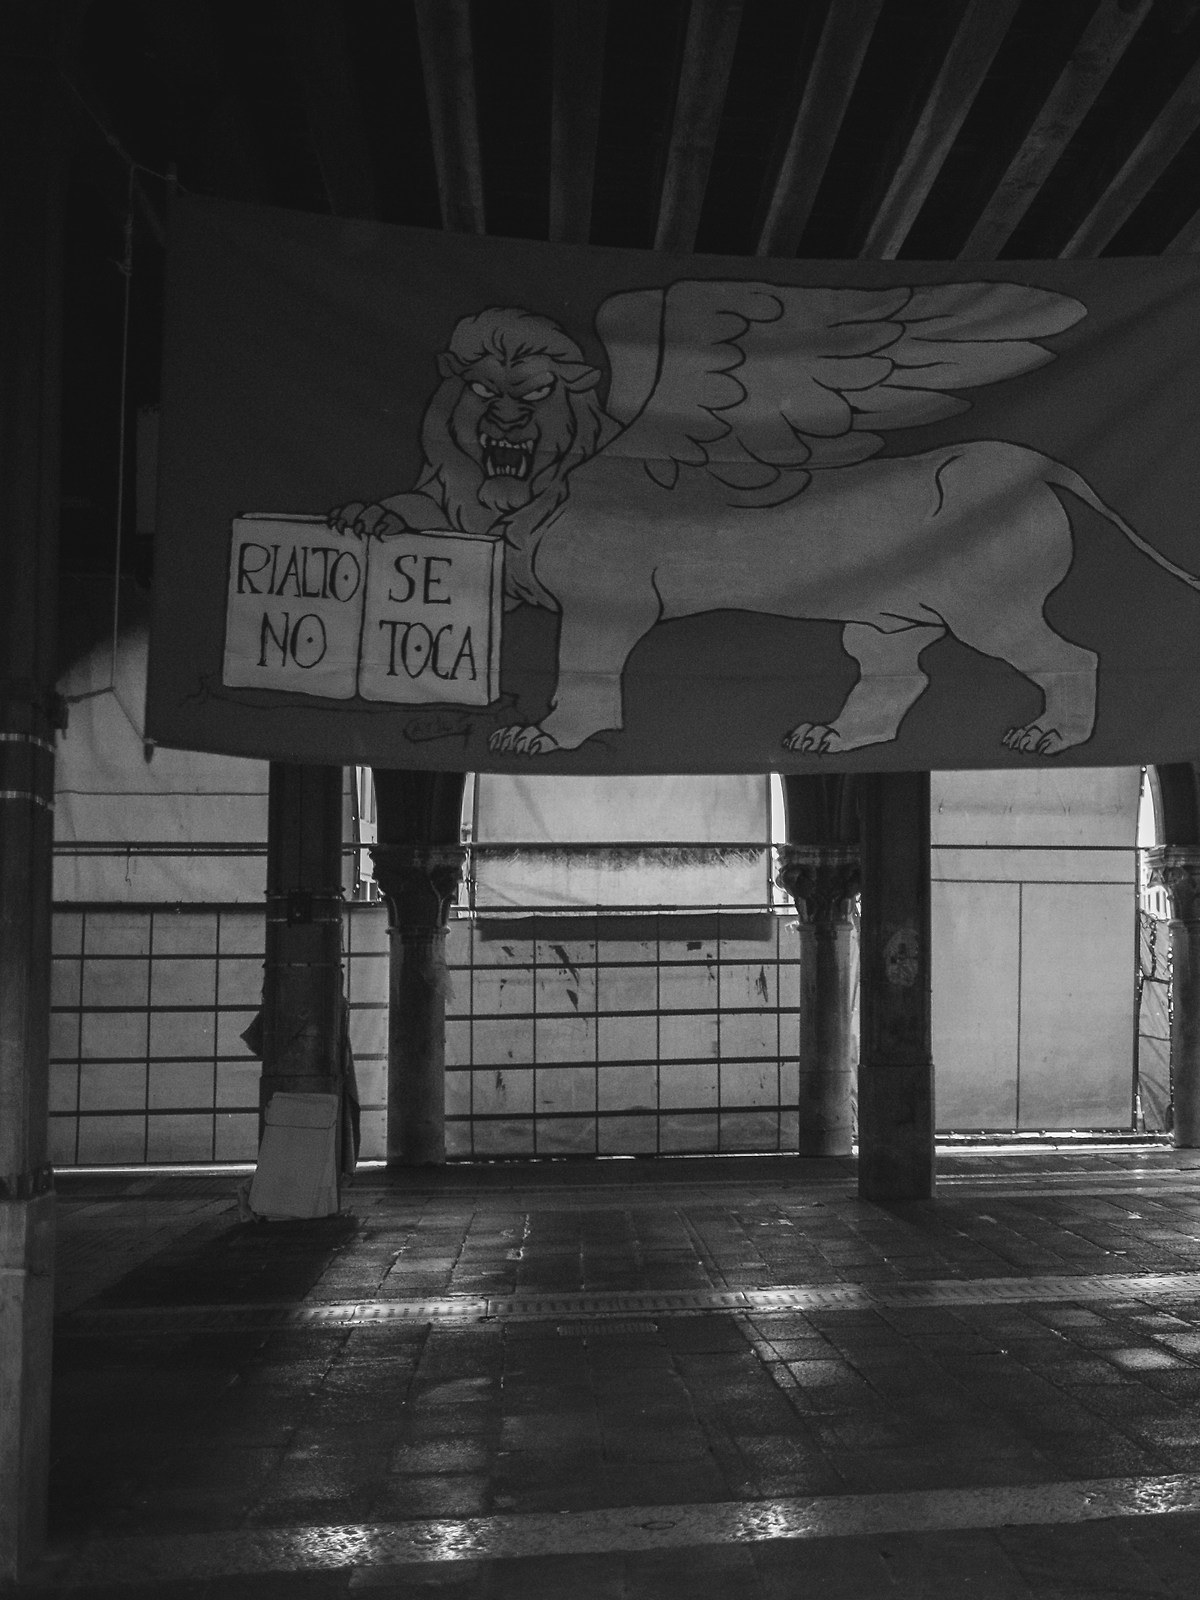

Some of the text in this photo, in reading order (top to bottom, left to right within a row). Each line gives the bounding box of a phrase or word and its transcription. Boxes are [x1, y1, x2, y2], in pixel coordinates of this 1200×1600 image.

[236, 543, 361, 602] RIALTO
[389, 554, 452, 604] SE
[256, 612, 327, 669] NO
[379, 619, 477, 681] TOCA
